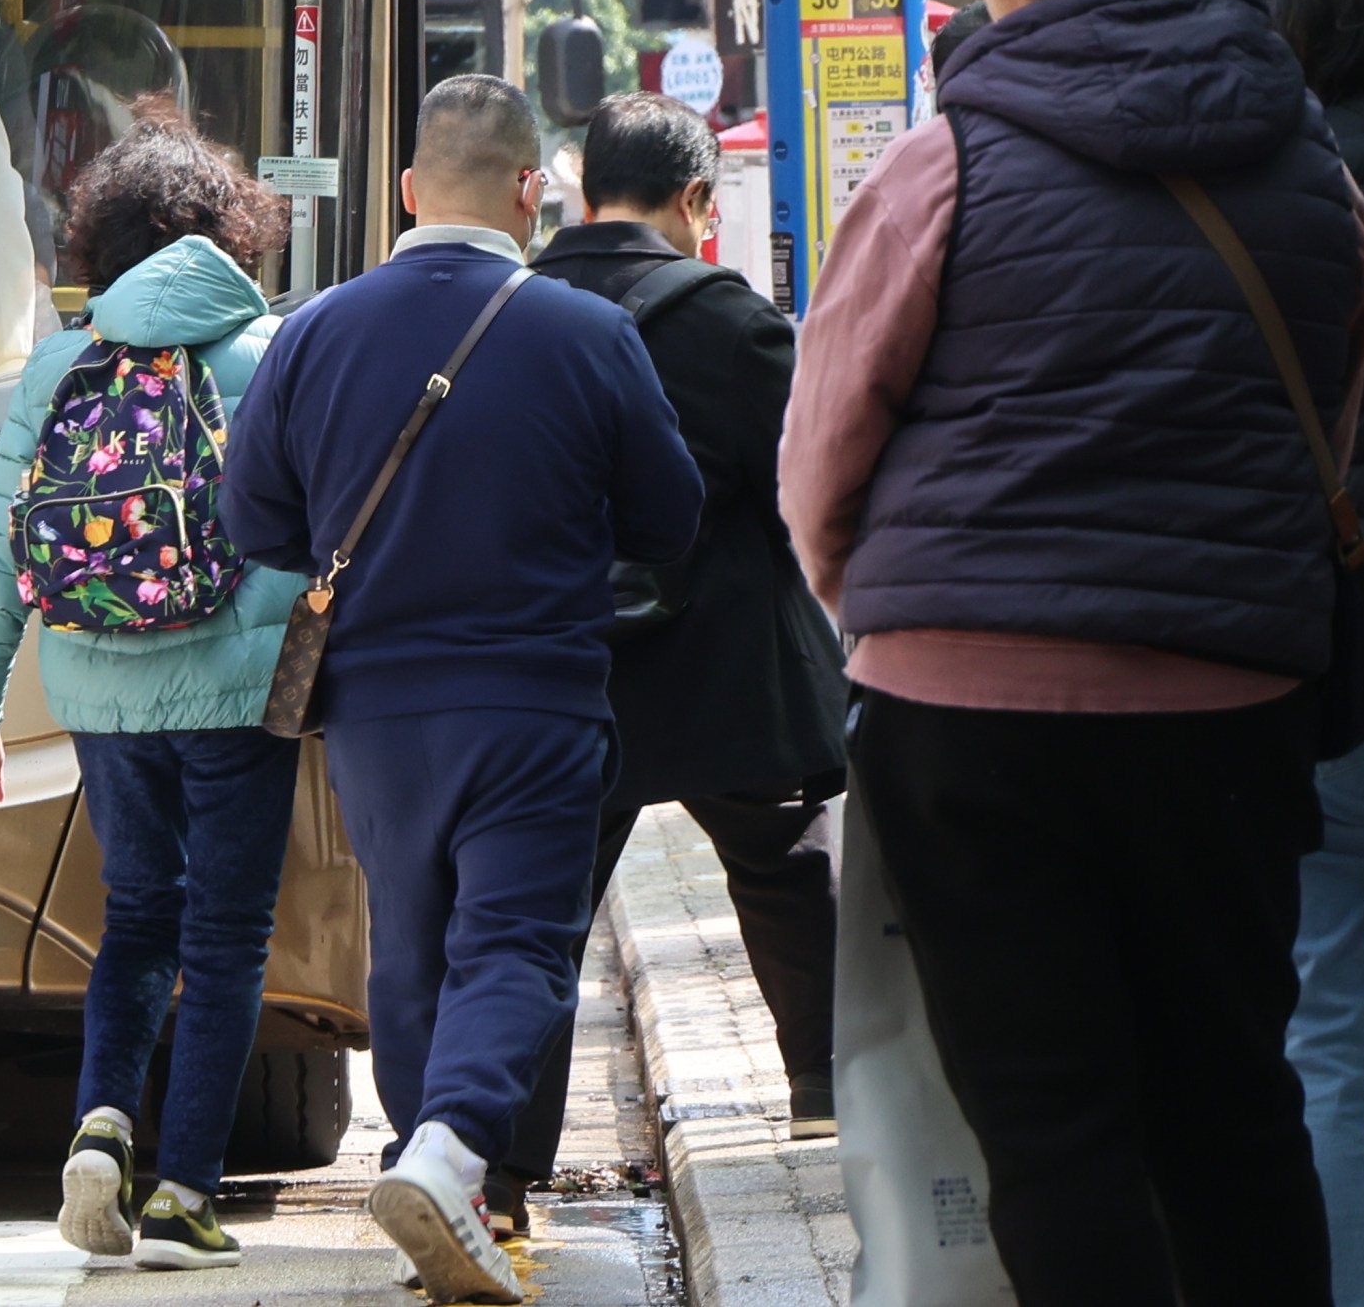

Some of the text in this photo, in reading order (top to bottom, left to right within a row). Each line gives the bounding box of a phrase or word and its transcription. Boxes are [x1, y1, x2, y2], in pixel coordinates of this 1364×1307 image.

[847, 23, 870, 32] Major
[826, 47, 885, 61] 屯門公路
[827, 64, 901, 79] 巴士轉乘站
[295, 48, 309, 145] 勿當扶手
[150, 1198, 172, 1211] NIKE
